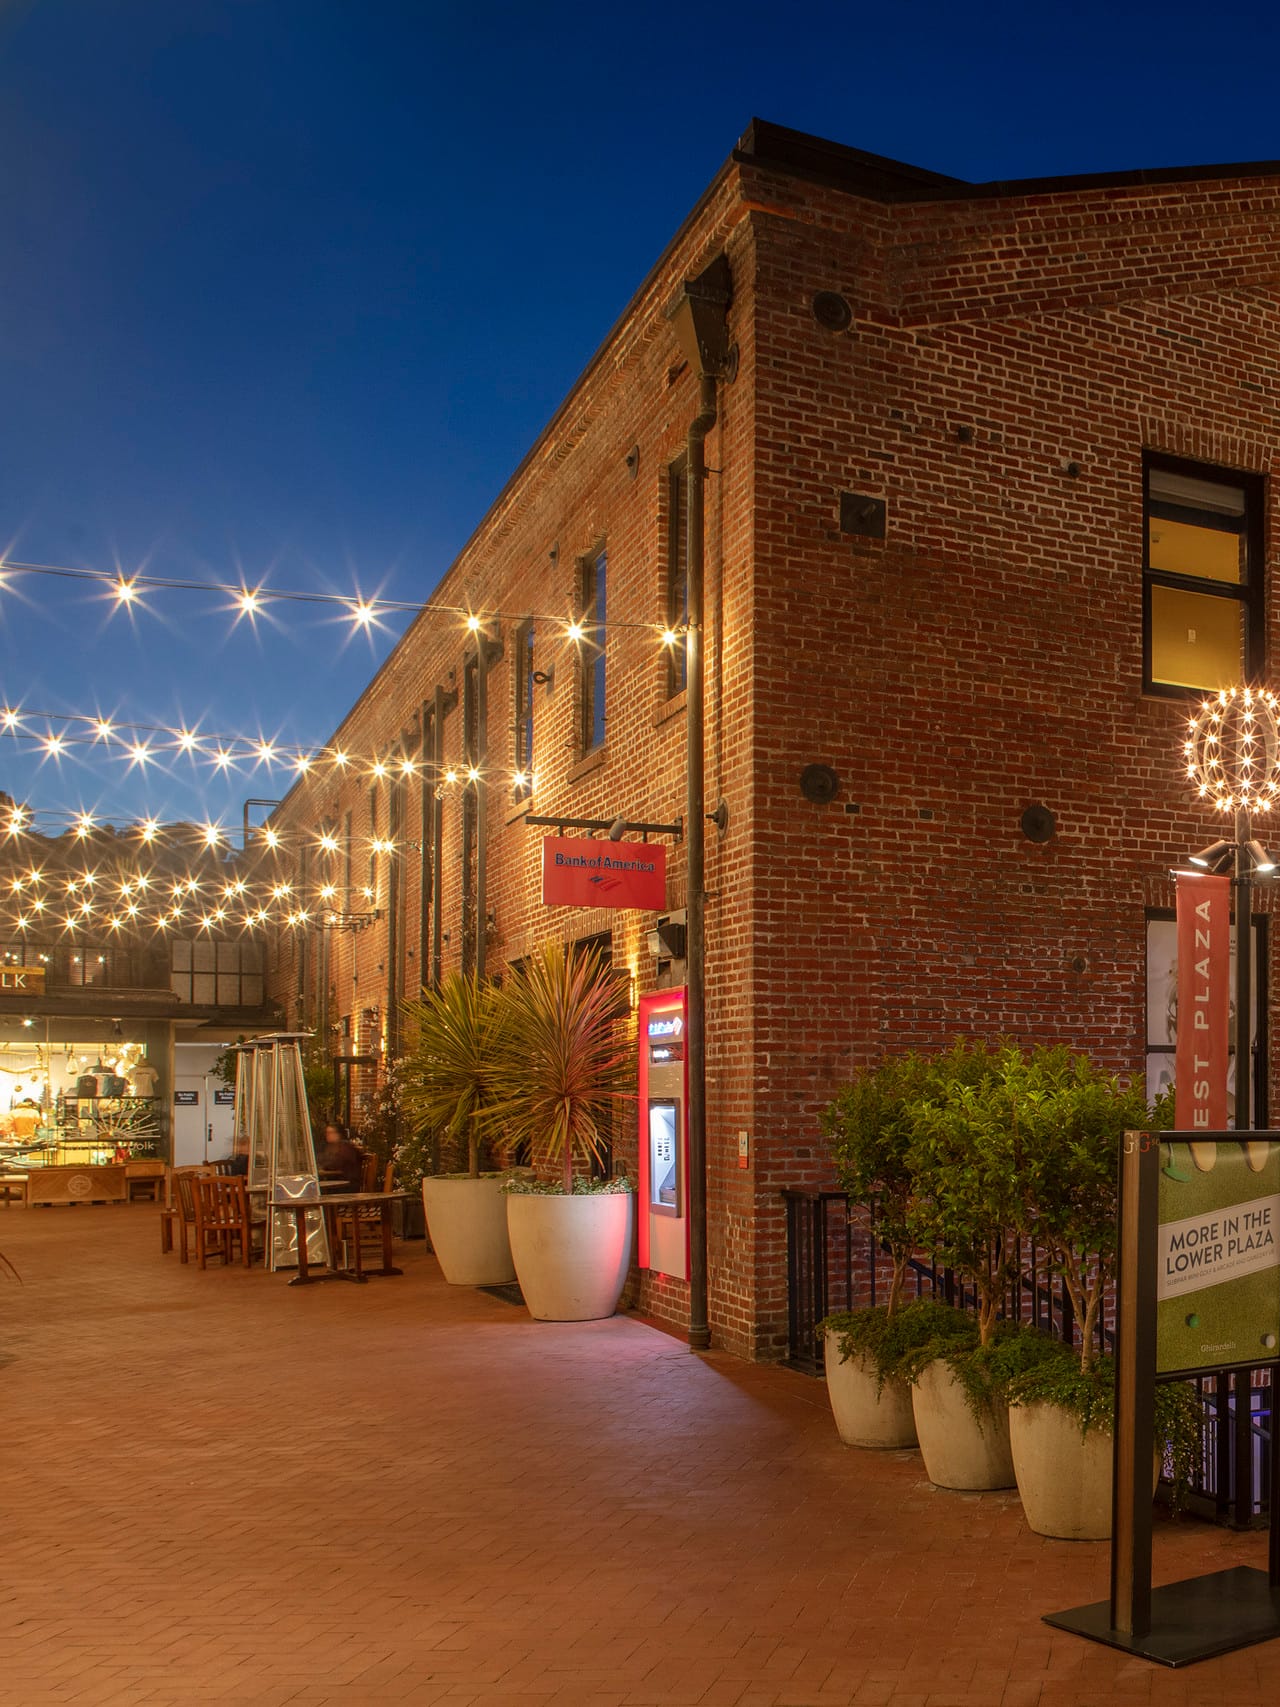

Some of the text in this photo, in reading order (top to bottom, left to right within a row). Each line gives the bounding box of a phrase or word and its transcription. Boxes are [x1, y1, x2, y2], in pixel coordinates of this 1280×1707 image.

[555, 852, 655, 872] Bank of America
[1193, 899, 1212, 1128] EST PLAZA
[1166, 1229, 1274, 1275] LOWER PLAZA
[1169, 1207, 1271, 1252] MORE IN THE
